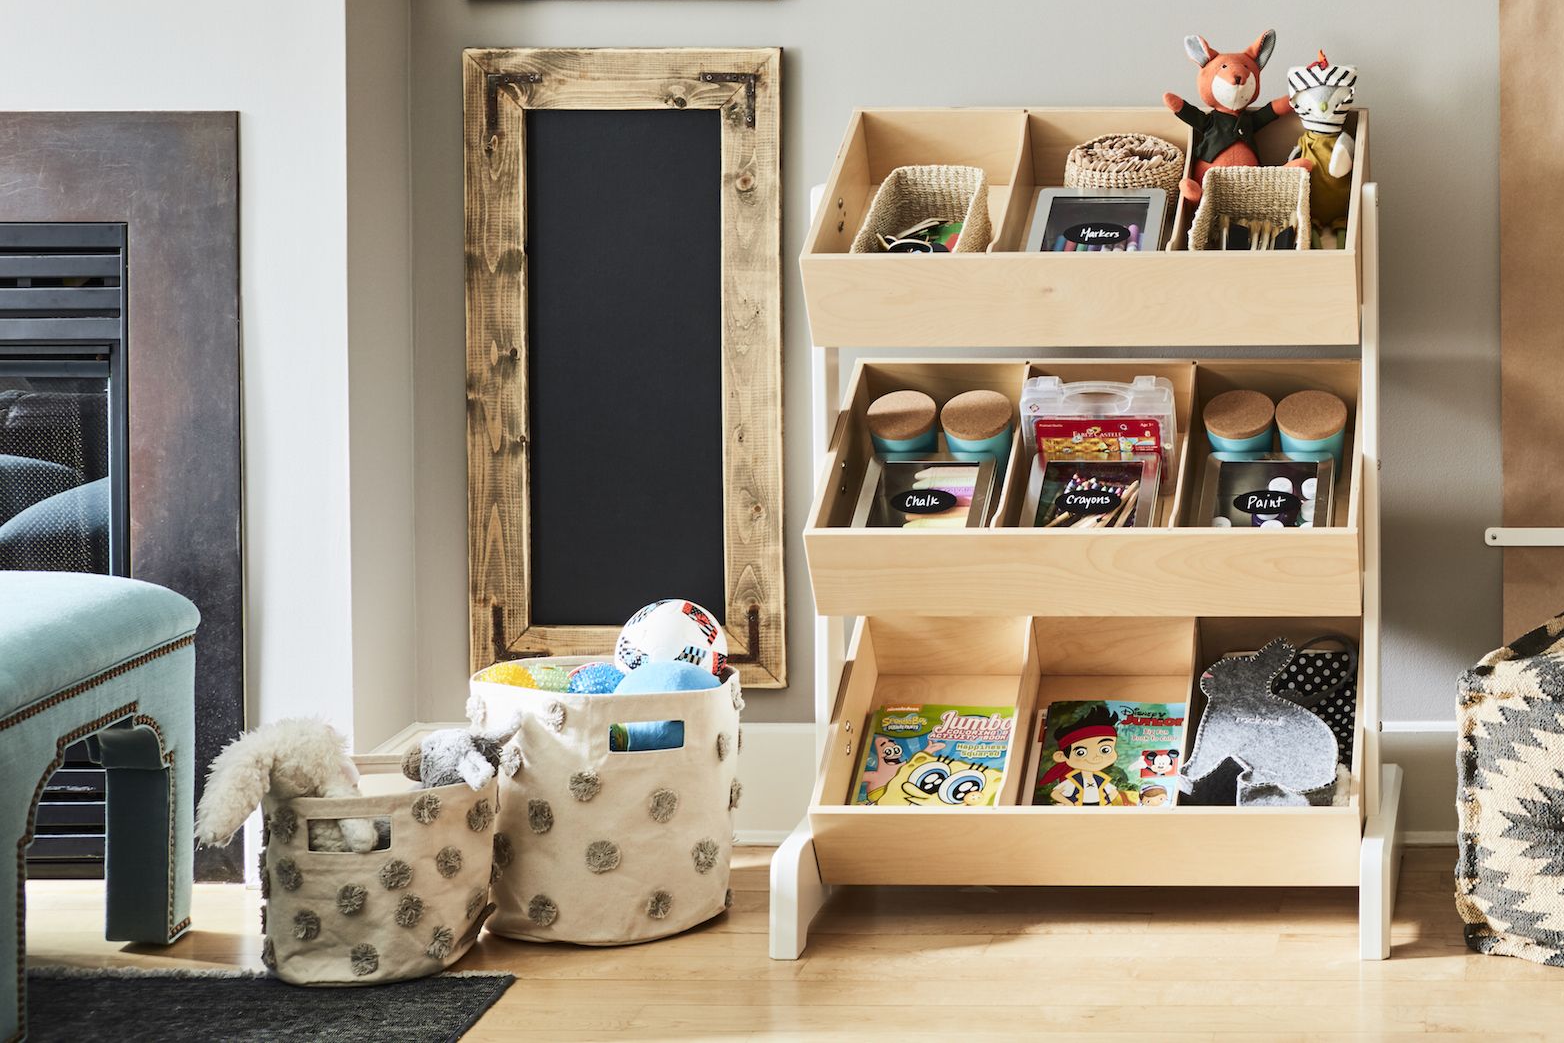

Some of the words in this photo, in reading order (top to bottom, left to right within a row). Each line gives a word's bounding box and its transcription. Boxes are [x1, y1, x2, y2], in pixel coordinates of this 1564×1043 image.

[1080, 227, 1120, 242] Markers
[905, 494, 940, 508] Chalk
[1066, 494, 1111, 509] Crayons
[1247, 493, 1287, 509] Paint
[933, 710, 1013, 734] Jumbo
[929, 733, 978, 741] ACTIVITY
[957, 743, 1007, 752] Happiness
